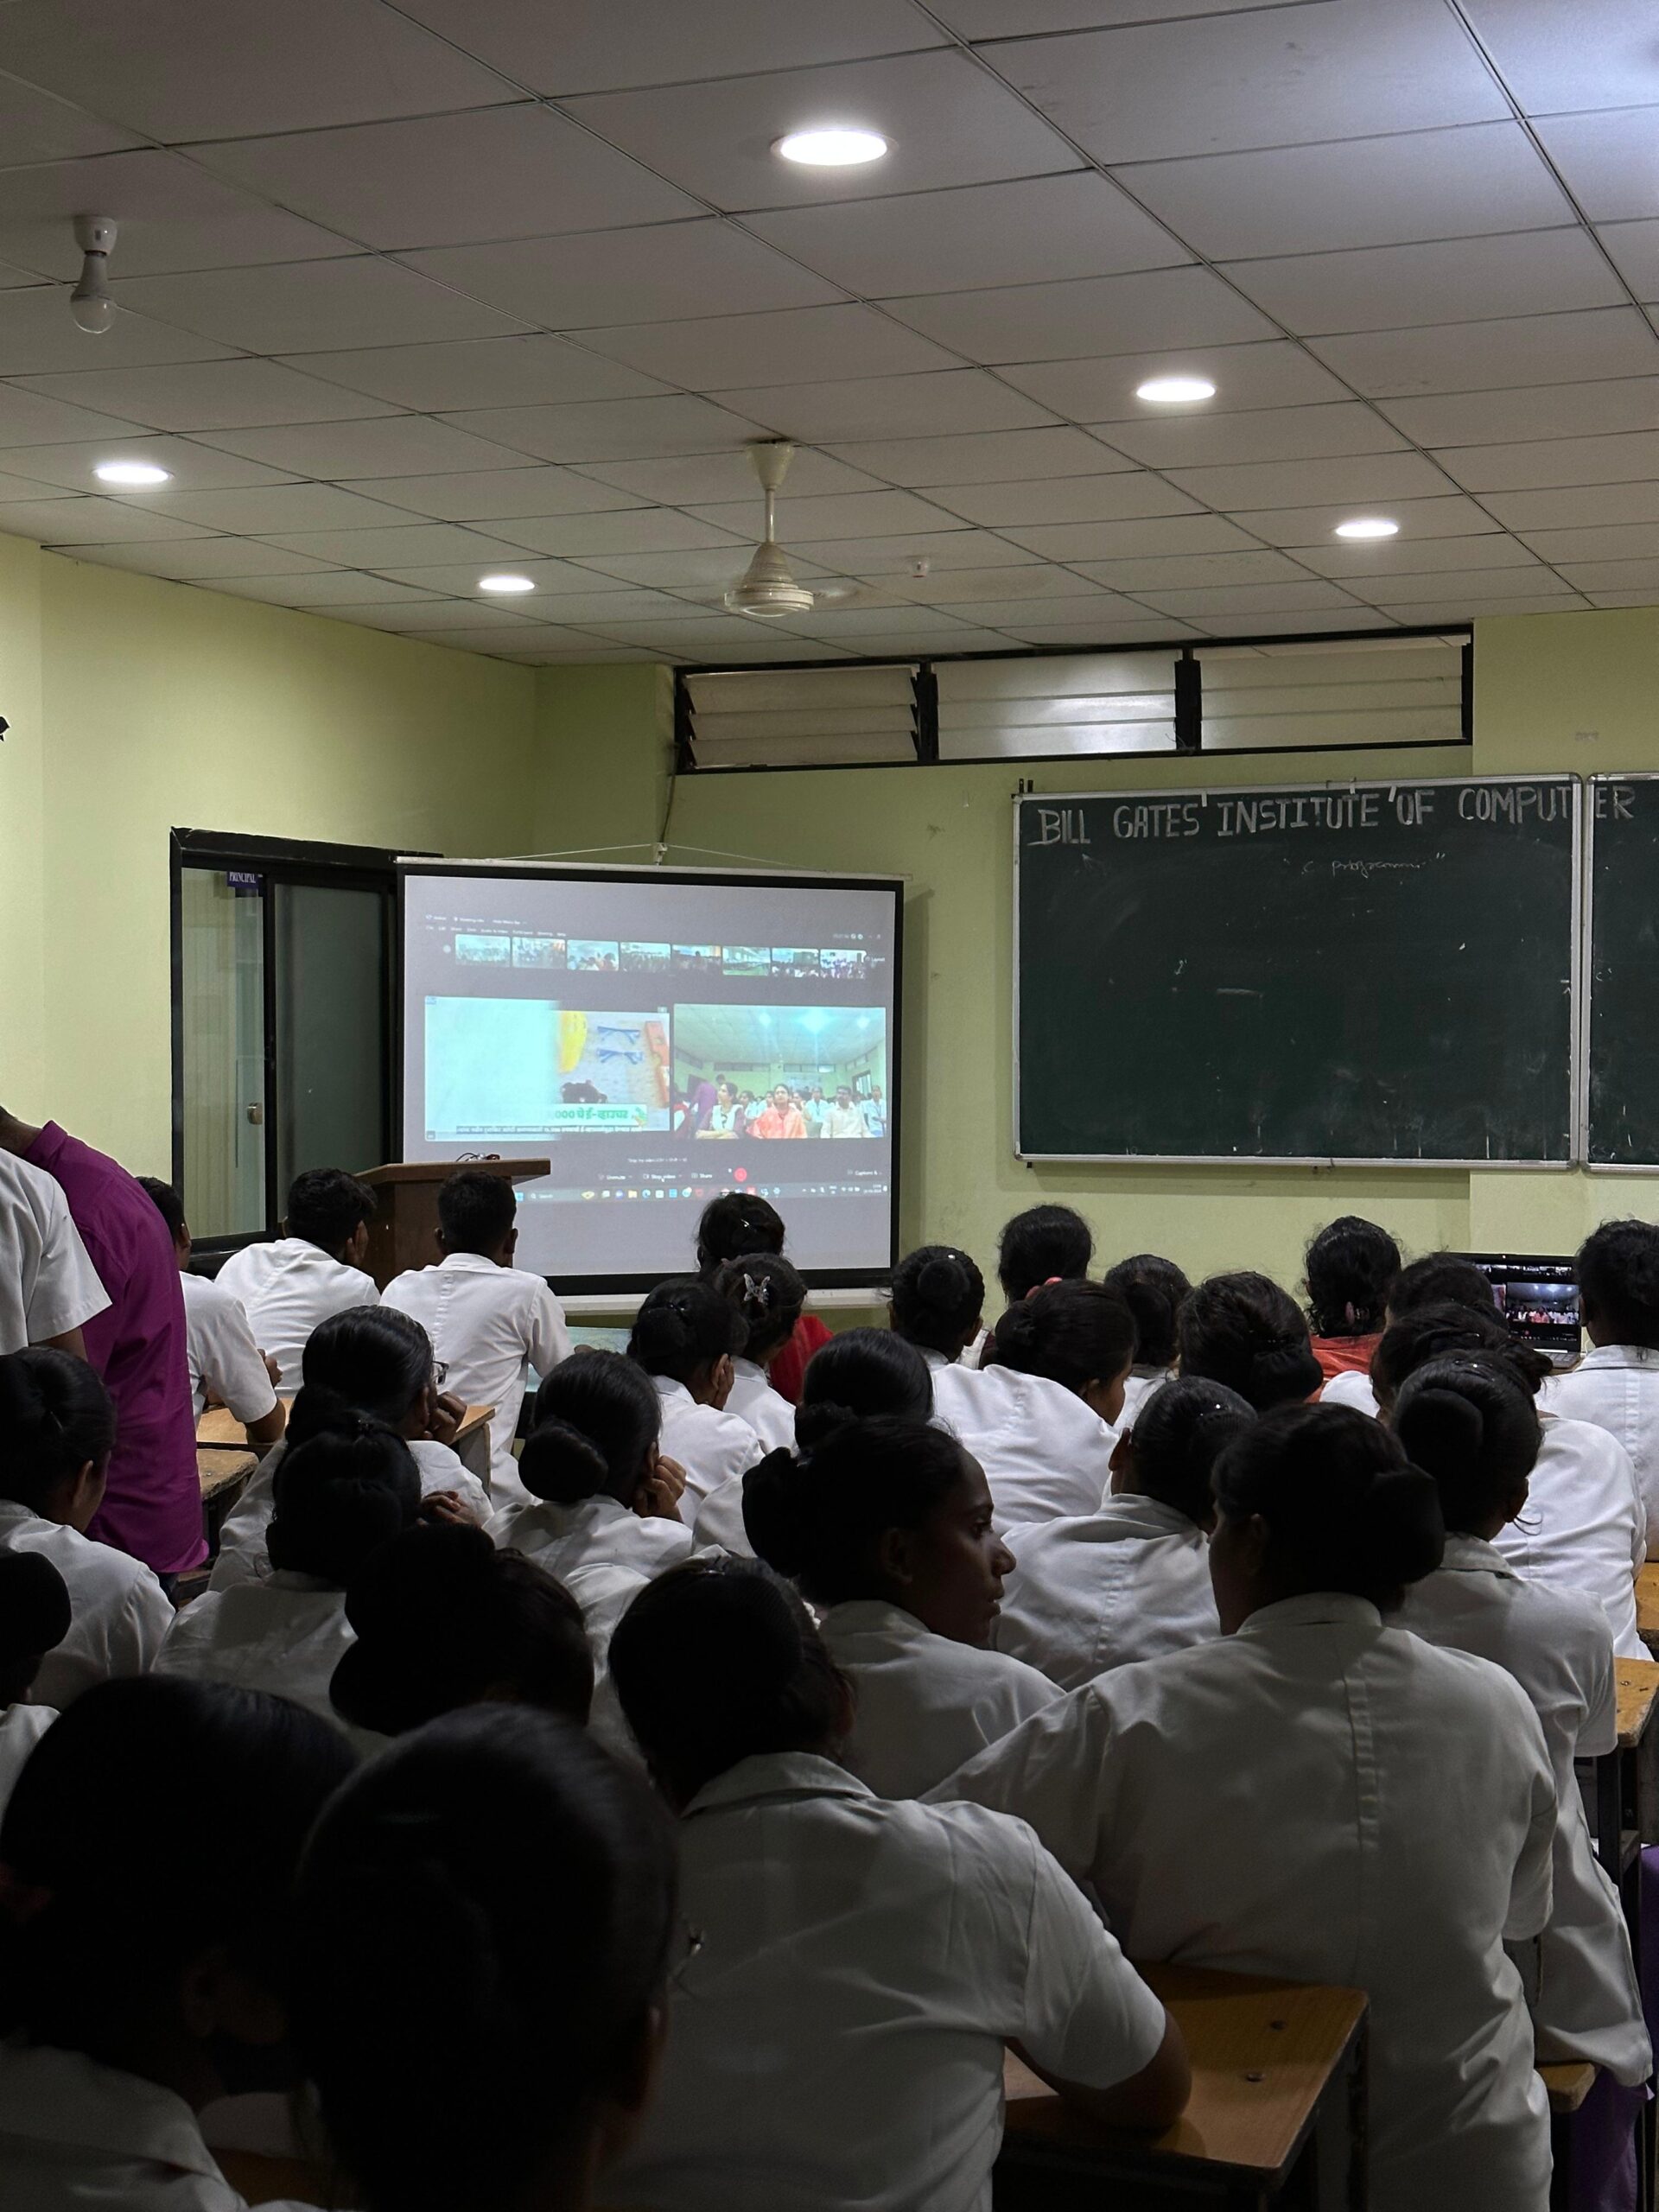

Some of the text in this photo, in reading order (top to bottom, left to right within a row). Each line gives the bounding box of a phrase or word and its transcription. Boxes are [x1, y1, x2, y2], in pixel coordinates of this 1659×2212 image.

[1028, 809, 1090, 846] BILL
[1113, 803, 1200, 839] GATES
[1217, 793, 1380, 836] INSTITUTE
[1396, 790, 1435, 825] OF
[229, 871, 257, 884] PRINCIPAL
